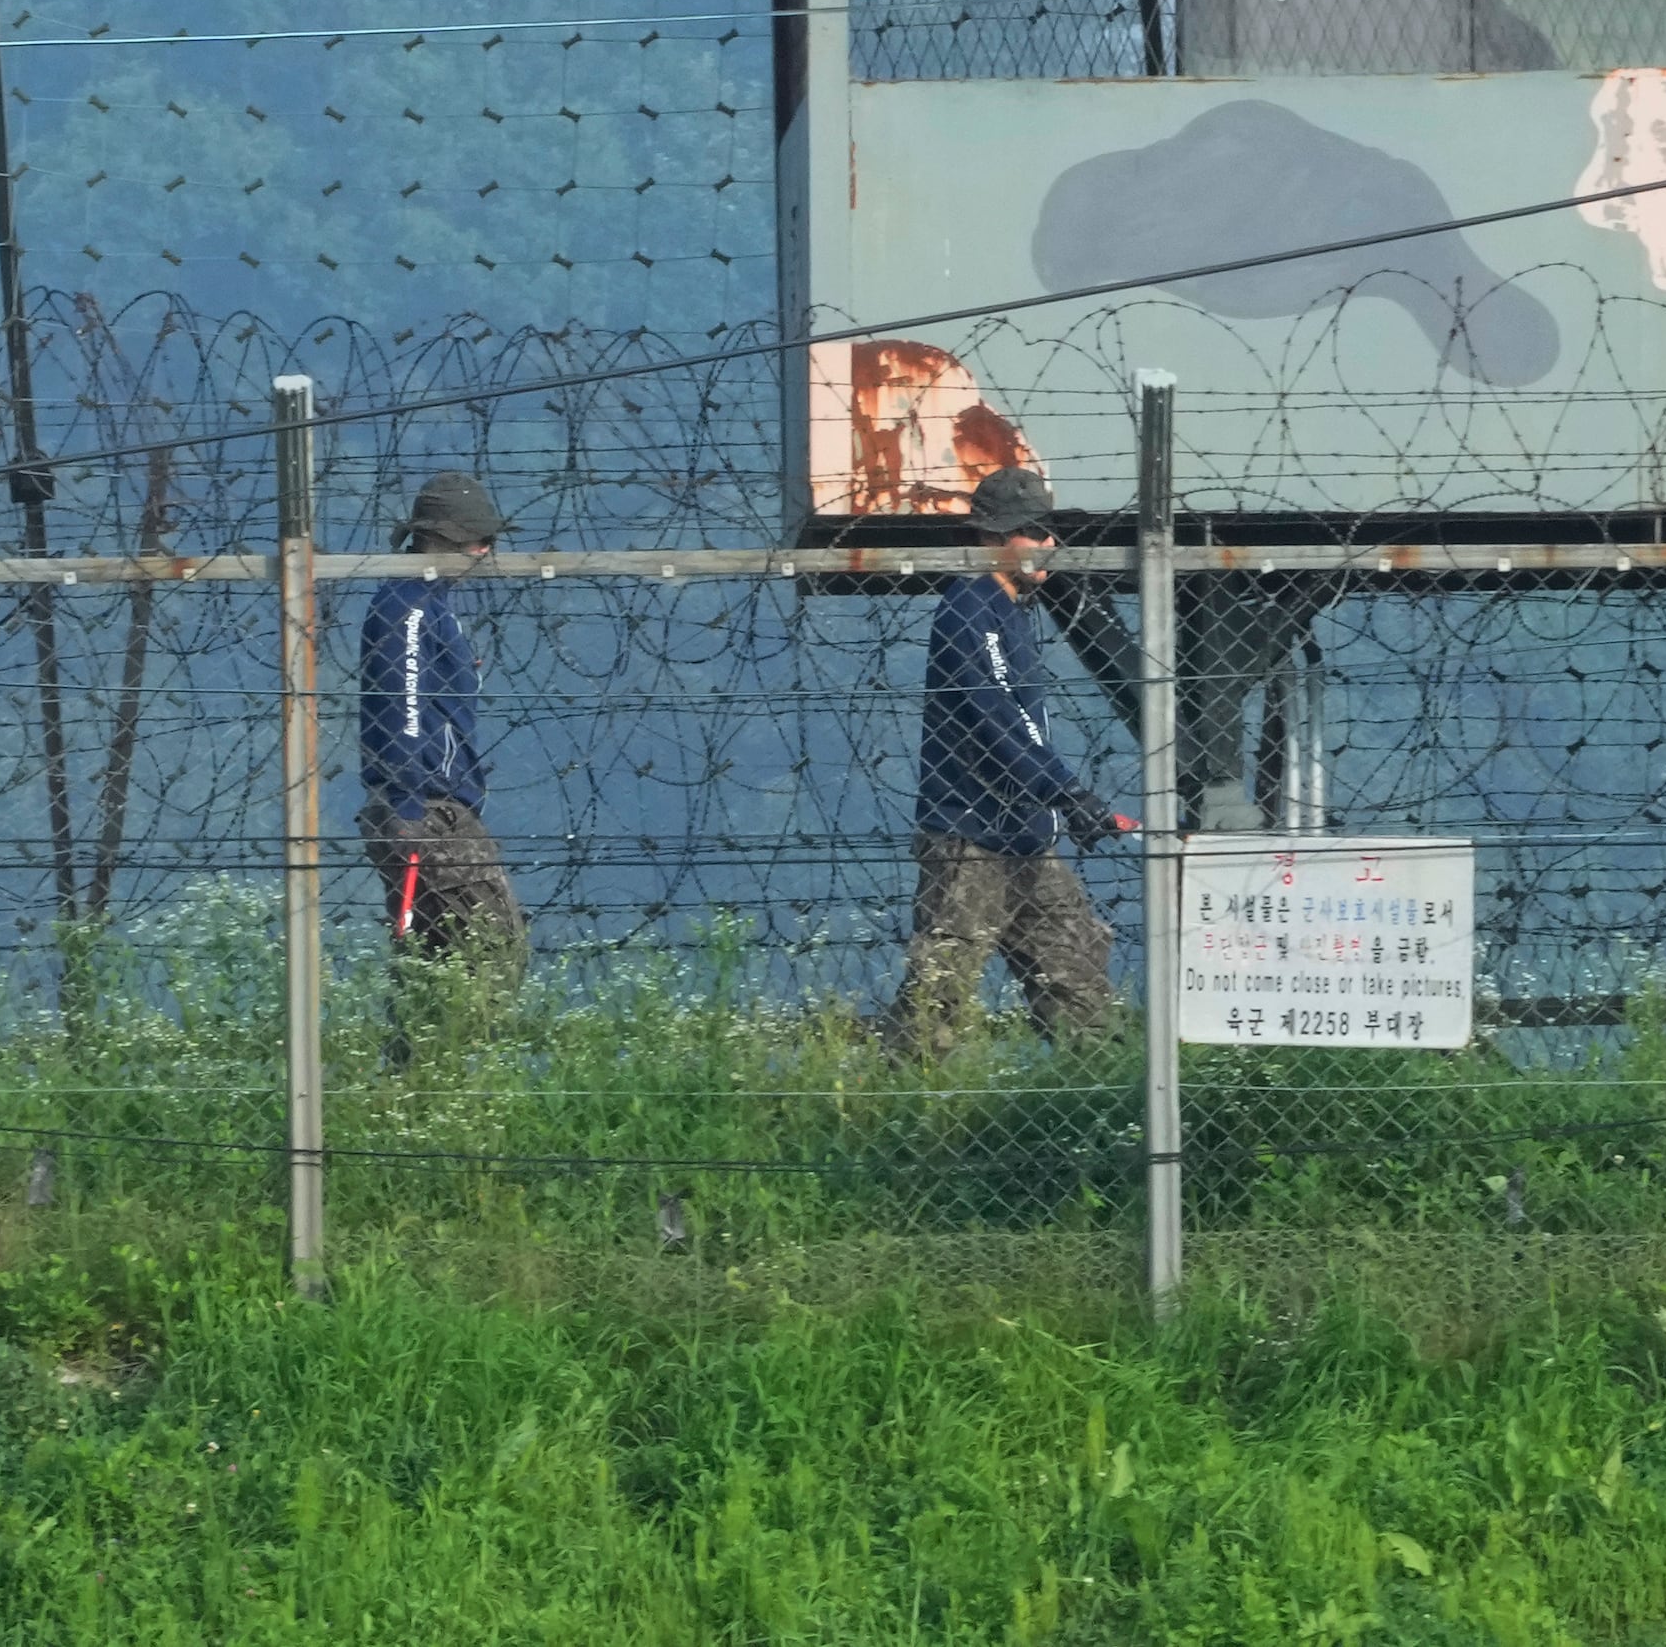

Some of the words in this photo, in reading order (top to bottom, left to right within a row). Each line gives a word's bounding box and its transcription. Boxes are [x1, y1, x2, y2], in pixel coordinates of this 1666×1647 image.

[404, 608, 424, 656] Republic
[405, 657, 419, 672] of
[985, 632, 1008, 681] Republic
[403, 706, 420, 738] Army
[1199, 893, 1212, 922] 본
[1226, 894, 1290, 923] 시설물은
[1275, 934, 1290, 964] 및
[1186, 967, 1205, 992] Do
[1213, 969, 1238, 992] not
[1244, 974, 1284, 993] come
[1291, 970, 1331, 994] close
[1339, 975, 1354, 994] or
[1362, 972, 1394, 996] take
[1401, 974, 1466, 1001] pictures.
[1226, 1009, 1265, 1037] 육군
[1279, 1009, 1350, 1038] 제2258
[1364, 1010, 1425, 1041] 부대장
